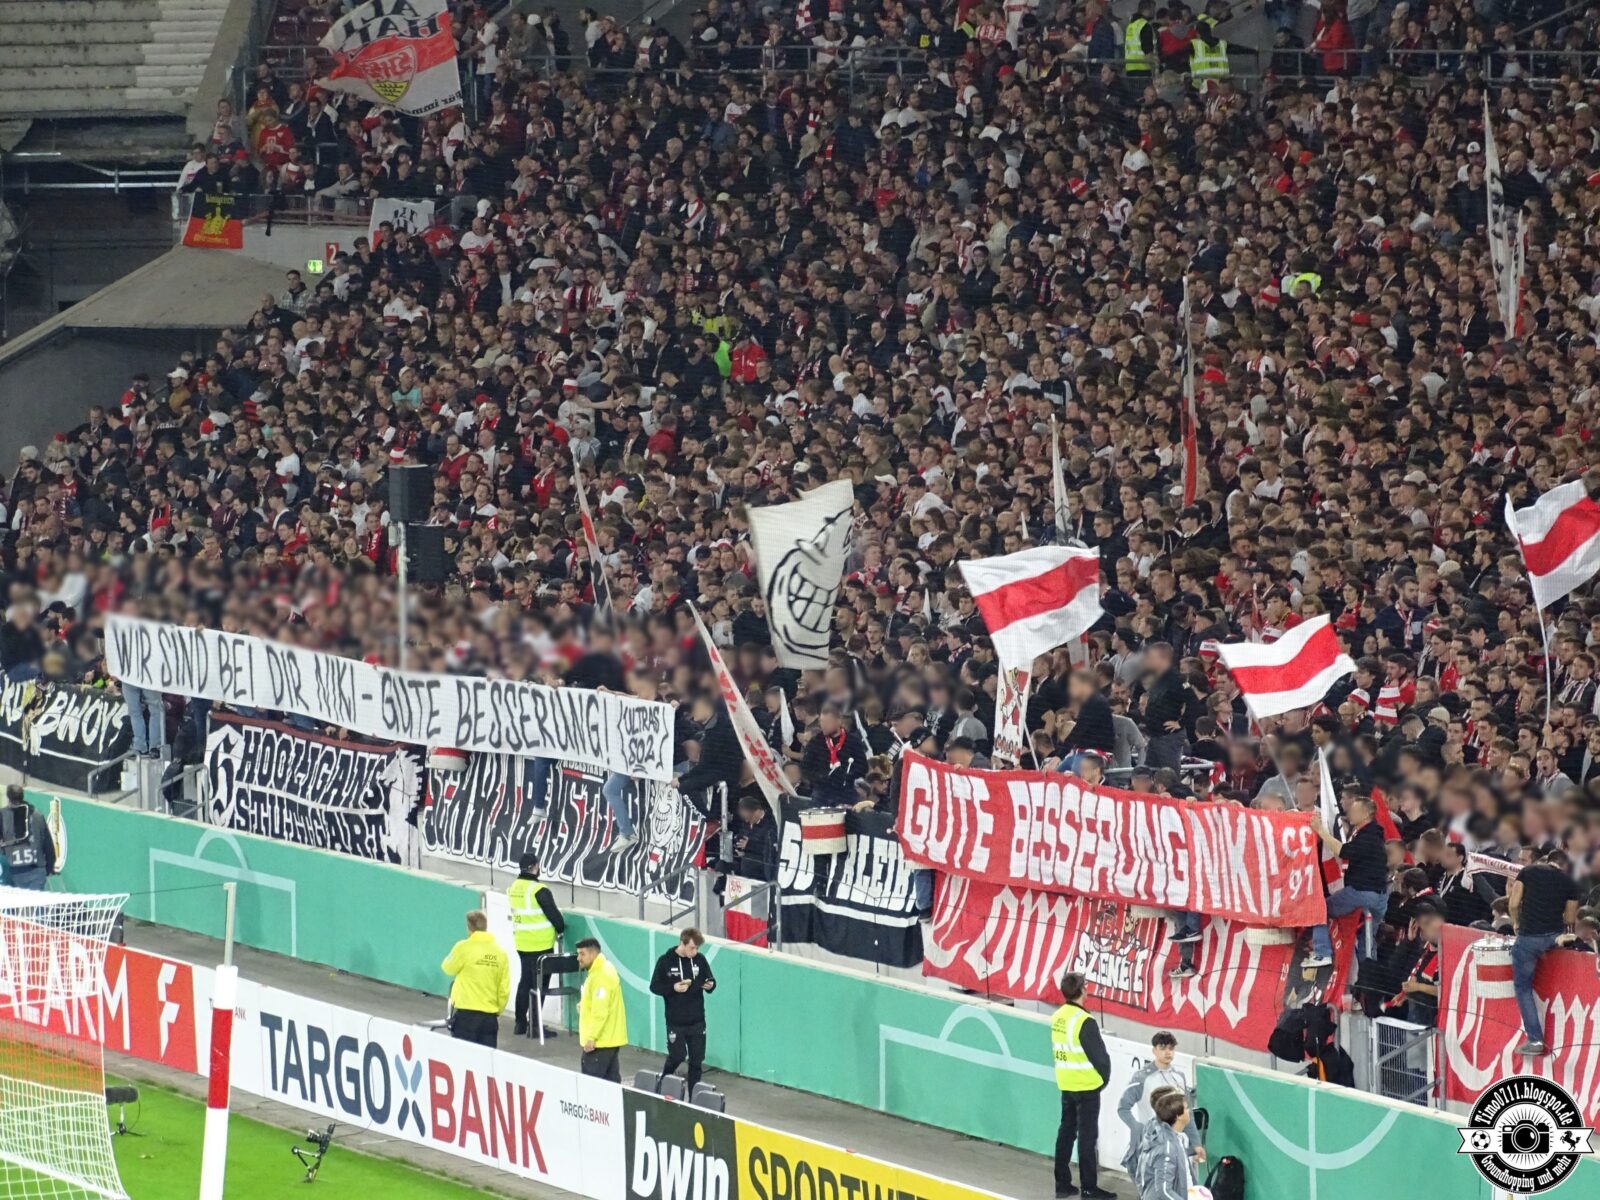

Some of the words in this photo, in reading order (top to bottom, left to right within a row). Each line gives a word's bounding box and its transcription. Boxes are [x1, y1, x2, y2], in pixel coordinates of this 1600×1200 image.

[328, 245, 337, 265] 2
[114, 624, 152, 685] WIR
[158, 626, 208, 694] SIND
[218, 634, 254, 702] BEI
[266, 644, 309, 711] DIR
[381, 670, 441, 740] GUTE
[455, 679, 611, 766] BESSERUNG!
[235, 727, 388, 811] HOOLIGANS
[233, 786, 390, 863] STUTTGART
[902, 761, 994, 873] GUTE
[1006, 780, 1190, 906] BESSERUNG
[1185, 805, 1282, 918] NIKI!
[1074, 931, 1132, 993] SZENE
[632, 1109, 729, 1200] bwin
